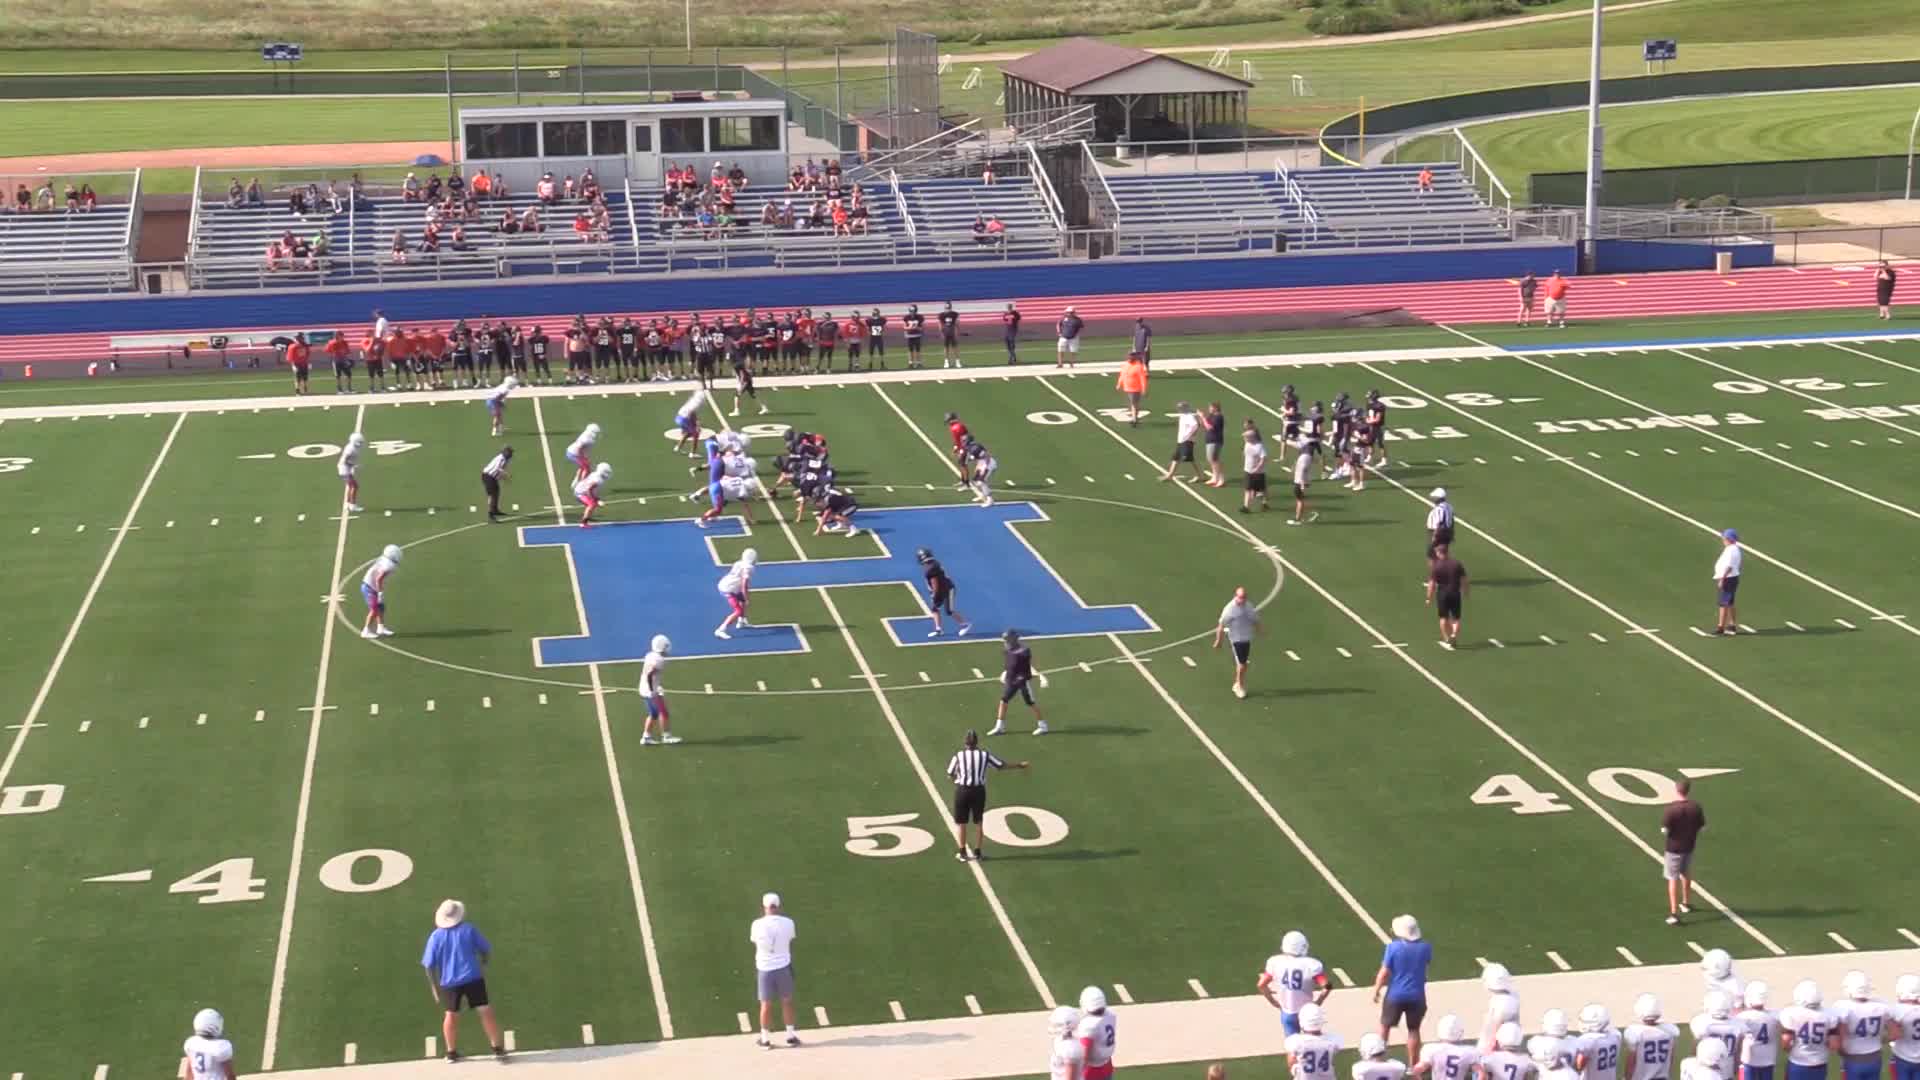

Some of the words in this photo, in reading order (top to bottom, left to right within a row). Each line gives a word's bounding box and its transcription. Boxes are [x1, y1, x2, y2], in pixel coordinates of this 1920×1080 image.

[1533, 412, 1766, 434] FAMILY
[1281, 968, 1304, 991] 49
[1755, 1022, 1770, 1045] 4
[1799, 1022, 1827, 1046] 45
[1854, 1016, 1882, 1038] 47
[194, 1051, 206, 1074] 3
[1302, 1050, 1330, 1074] 34
[1597, 1043, 1618, 1071] 22
[1643, 1039, 1670, 1064] 25
[1445, 1054, 1460, 1078] 5
[1503, 1063, 1518, 1080] 7
